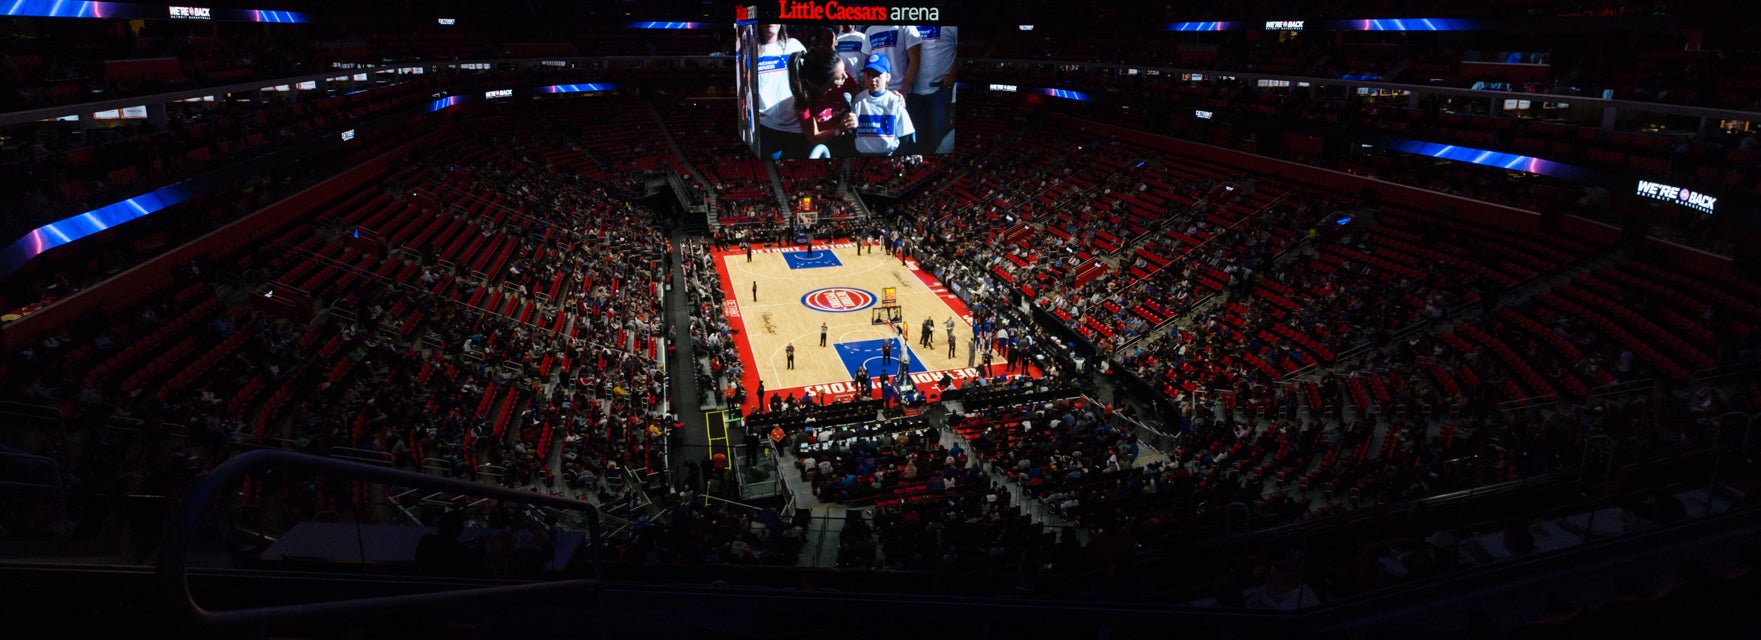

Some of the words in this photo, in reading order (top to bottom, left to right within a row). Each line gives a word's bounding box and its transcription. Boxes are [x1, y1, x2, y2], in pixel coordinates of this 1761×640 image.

[194, 7, 210, 17] BACK
[779, 0, 823, 19] Little
[825, 1, 887, 20] Caesars
[890, 7, 939, 21] arena
[1637, 180, 1680, 199] WE'RE
[1688, 191, 1717, 210] BACK
[910, 367, 980, 384] DETROI
